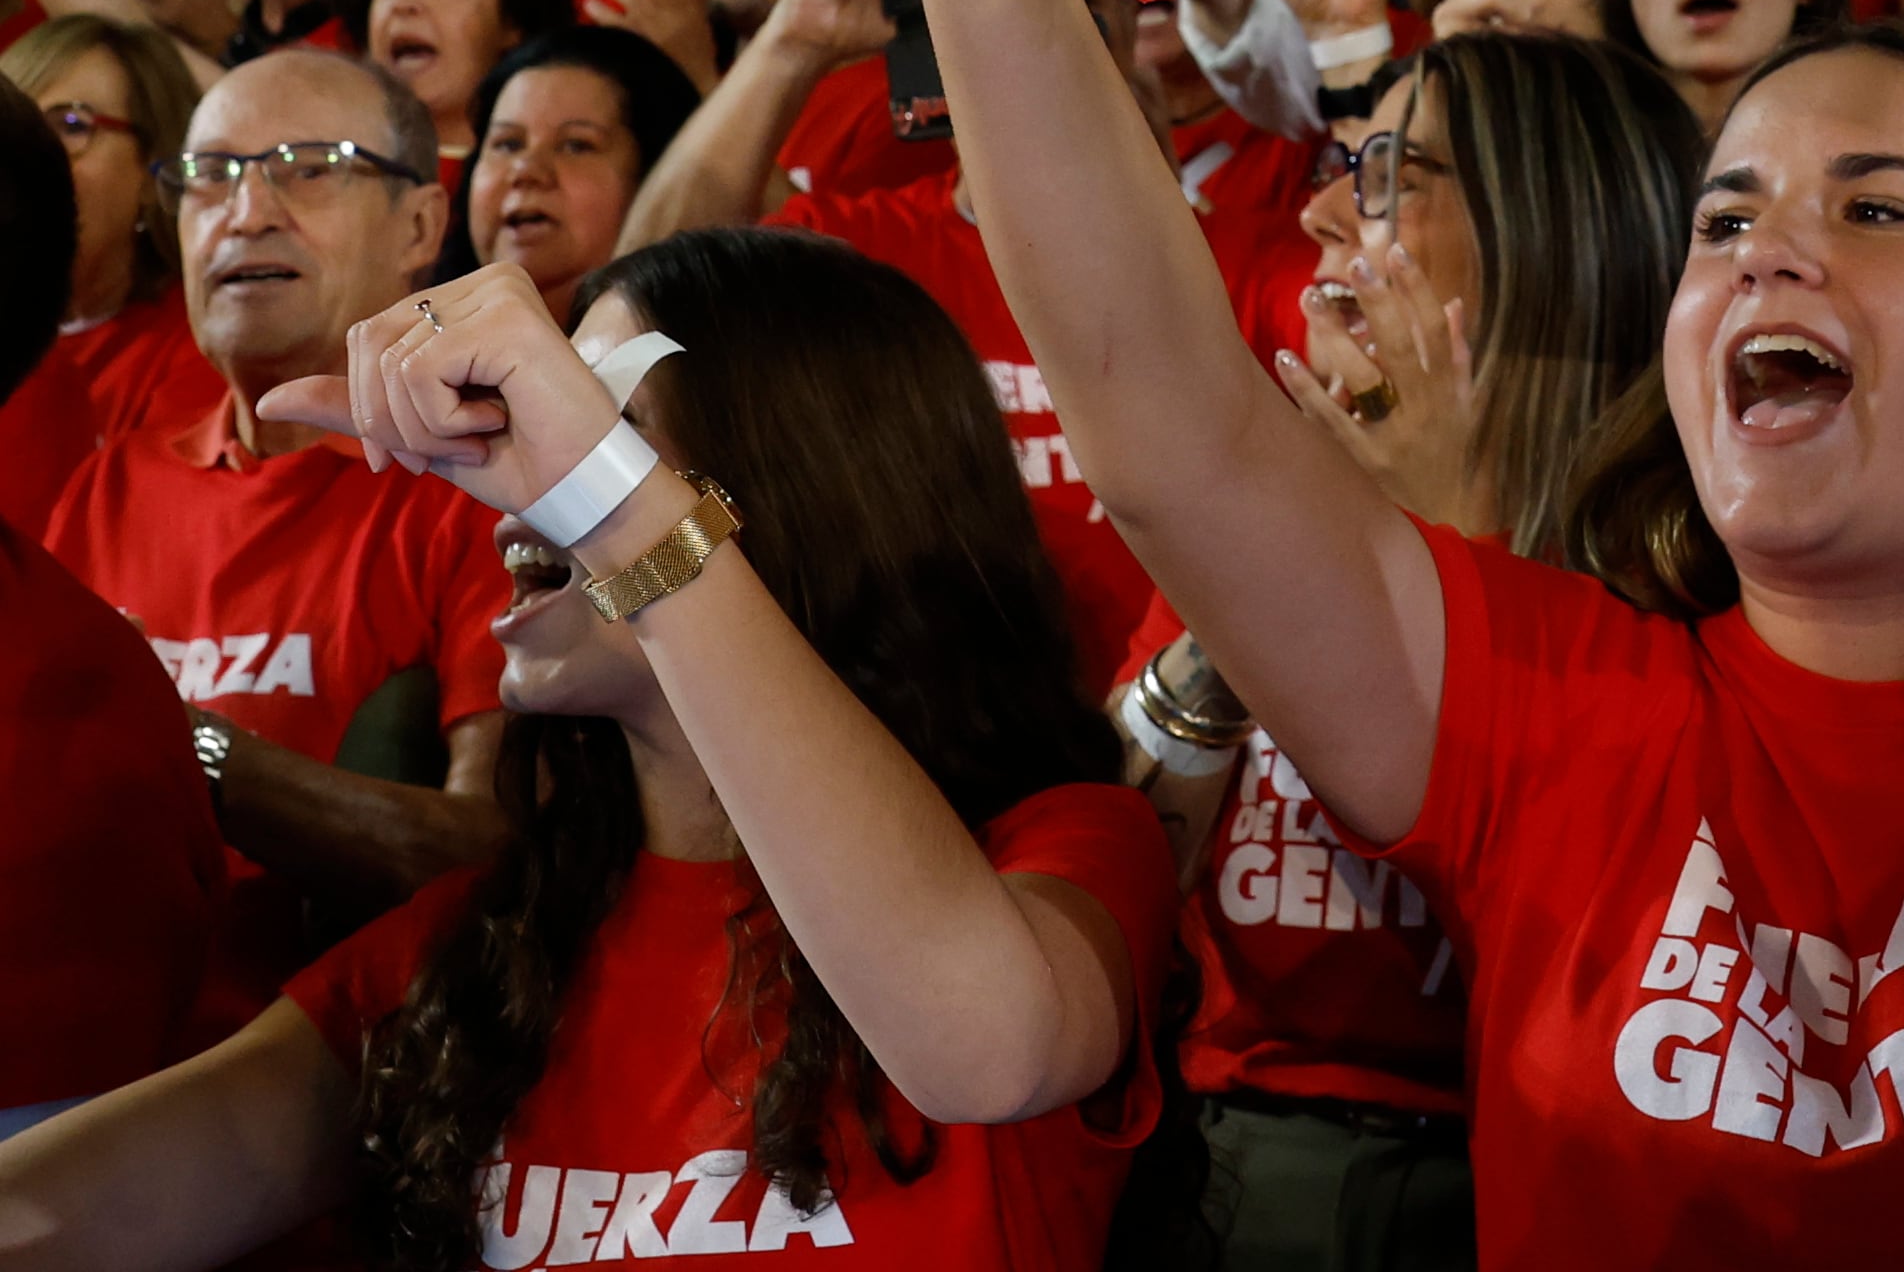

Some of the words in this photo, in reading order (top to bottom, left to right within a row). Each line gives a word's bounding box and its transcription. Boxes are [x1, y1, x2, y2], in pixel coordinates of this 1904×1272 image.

[1230, 800, 1278, 844] DE
[1639, 936, 1740, 1003] DE
[1736, 966, 1805, 1069] LA
